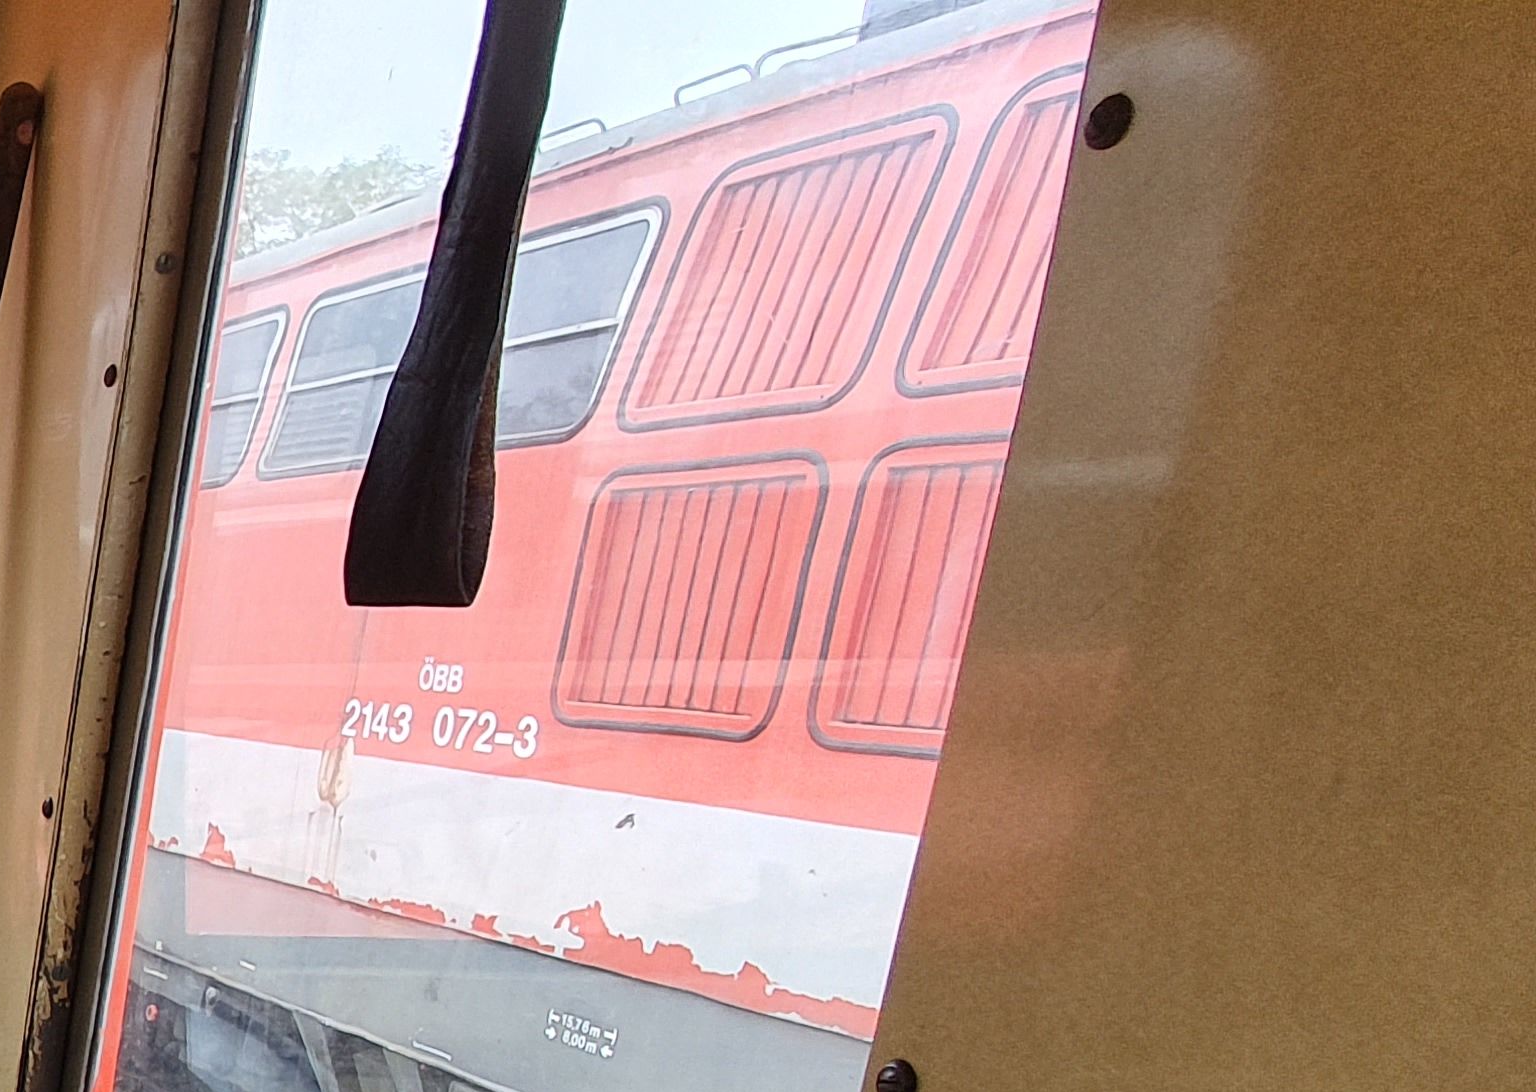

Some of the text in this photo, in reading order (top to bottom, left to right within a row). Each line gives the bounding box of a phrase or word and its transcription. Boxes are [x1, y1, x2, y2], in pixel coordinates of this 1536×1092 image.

[419, 657, 464, 693] ÖBB
[341, 698, 539, 759] 2143 072-3
